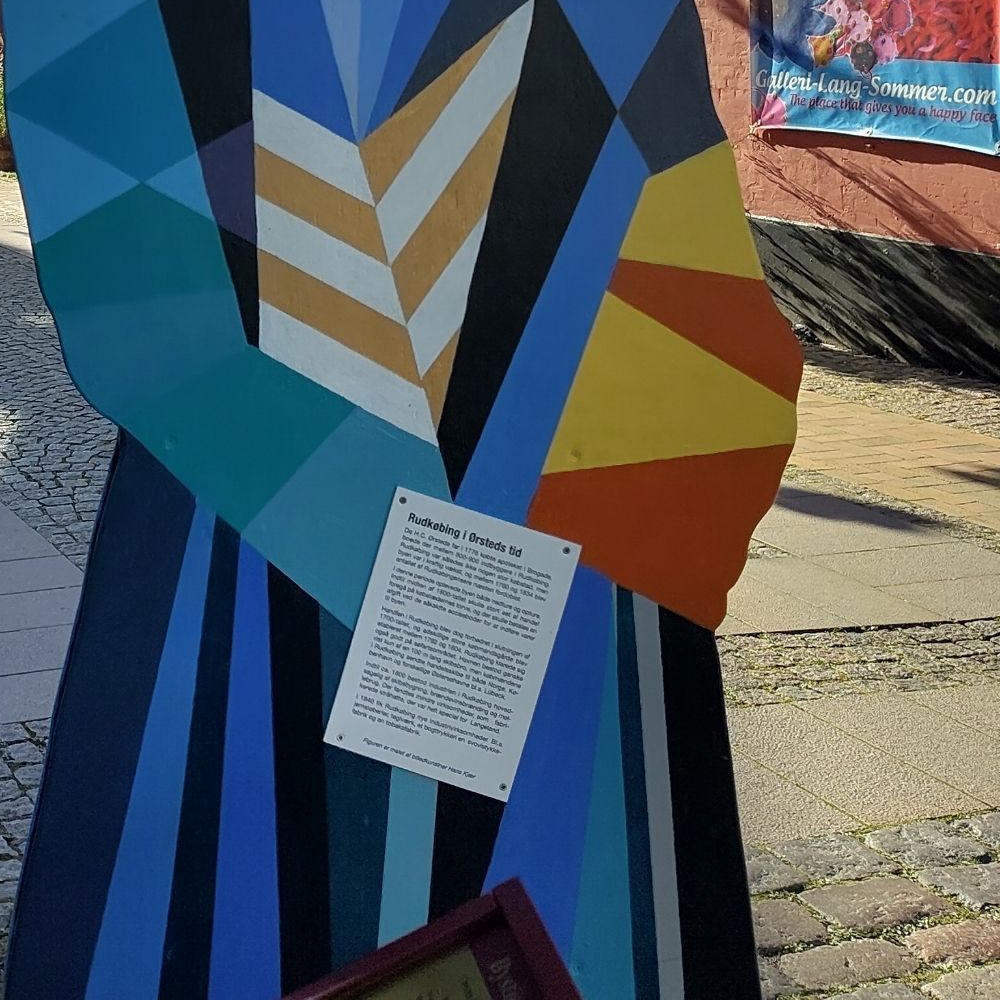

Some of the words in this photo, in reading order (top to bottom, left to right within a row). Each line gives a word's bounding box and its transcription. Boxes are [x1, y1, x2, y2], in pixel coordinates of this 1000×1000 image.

[755, 69, 997, 105] Galleri-Lang-Sommer.com
[790, 93, 806, 106] The
[809, 95, 837, 110] place
[840, 97, 863, 110] that
[864, 100, 892, 114] gives
[895, 104, 916, 117] you
[918, 107, 926, 117] a
[929, 106, 966, 122] happy
[970, 108, 997, 123] face
[407, 512, 460, 539] Rudkøbing
[462, 529, 467, 540] i
[468, 532, 506, 553] Ørsteds
[508, 545, 523, 558] tid
